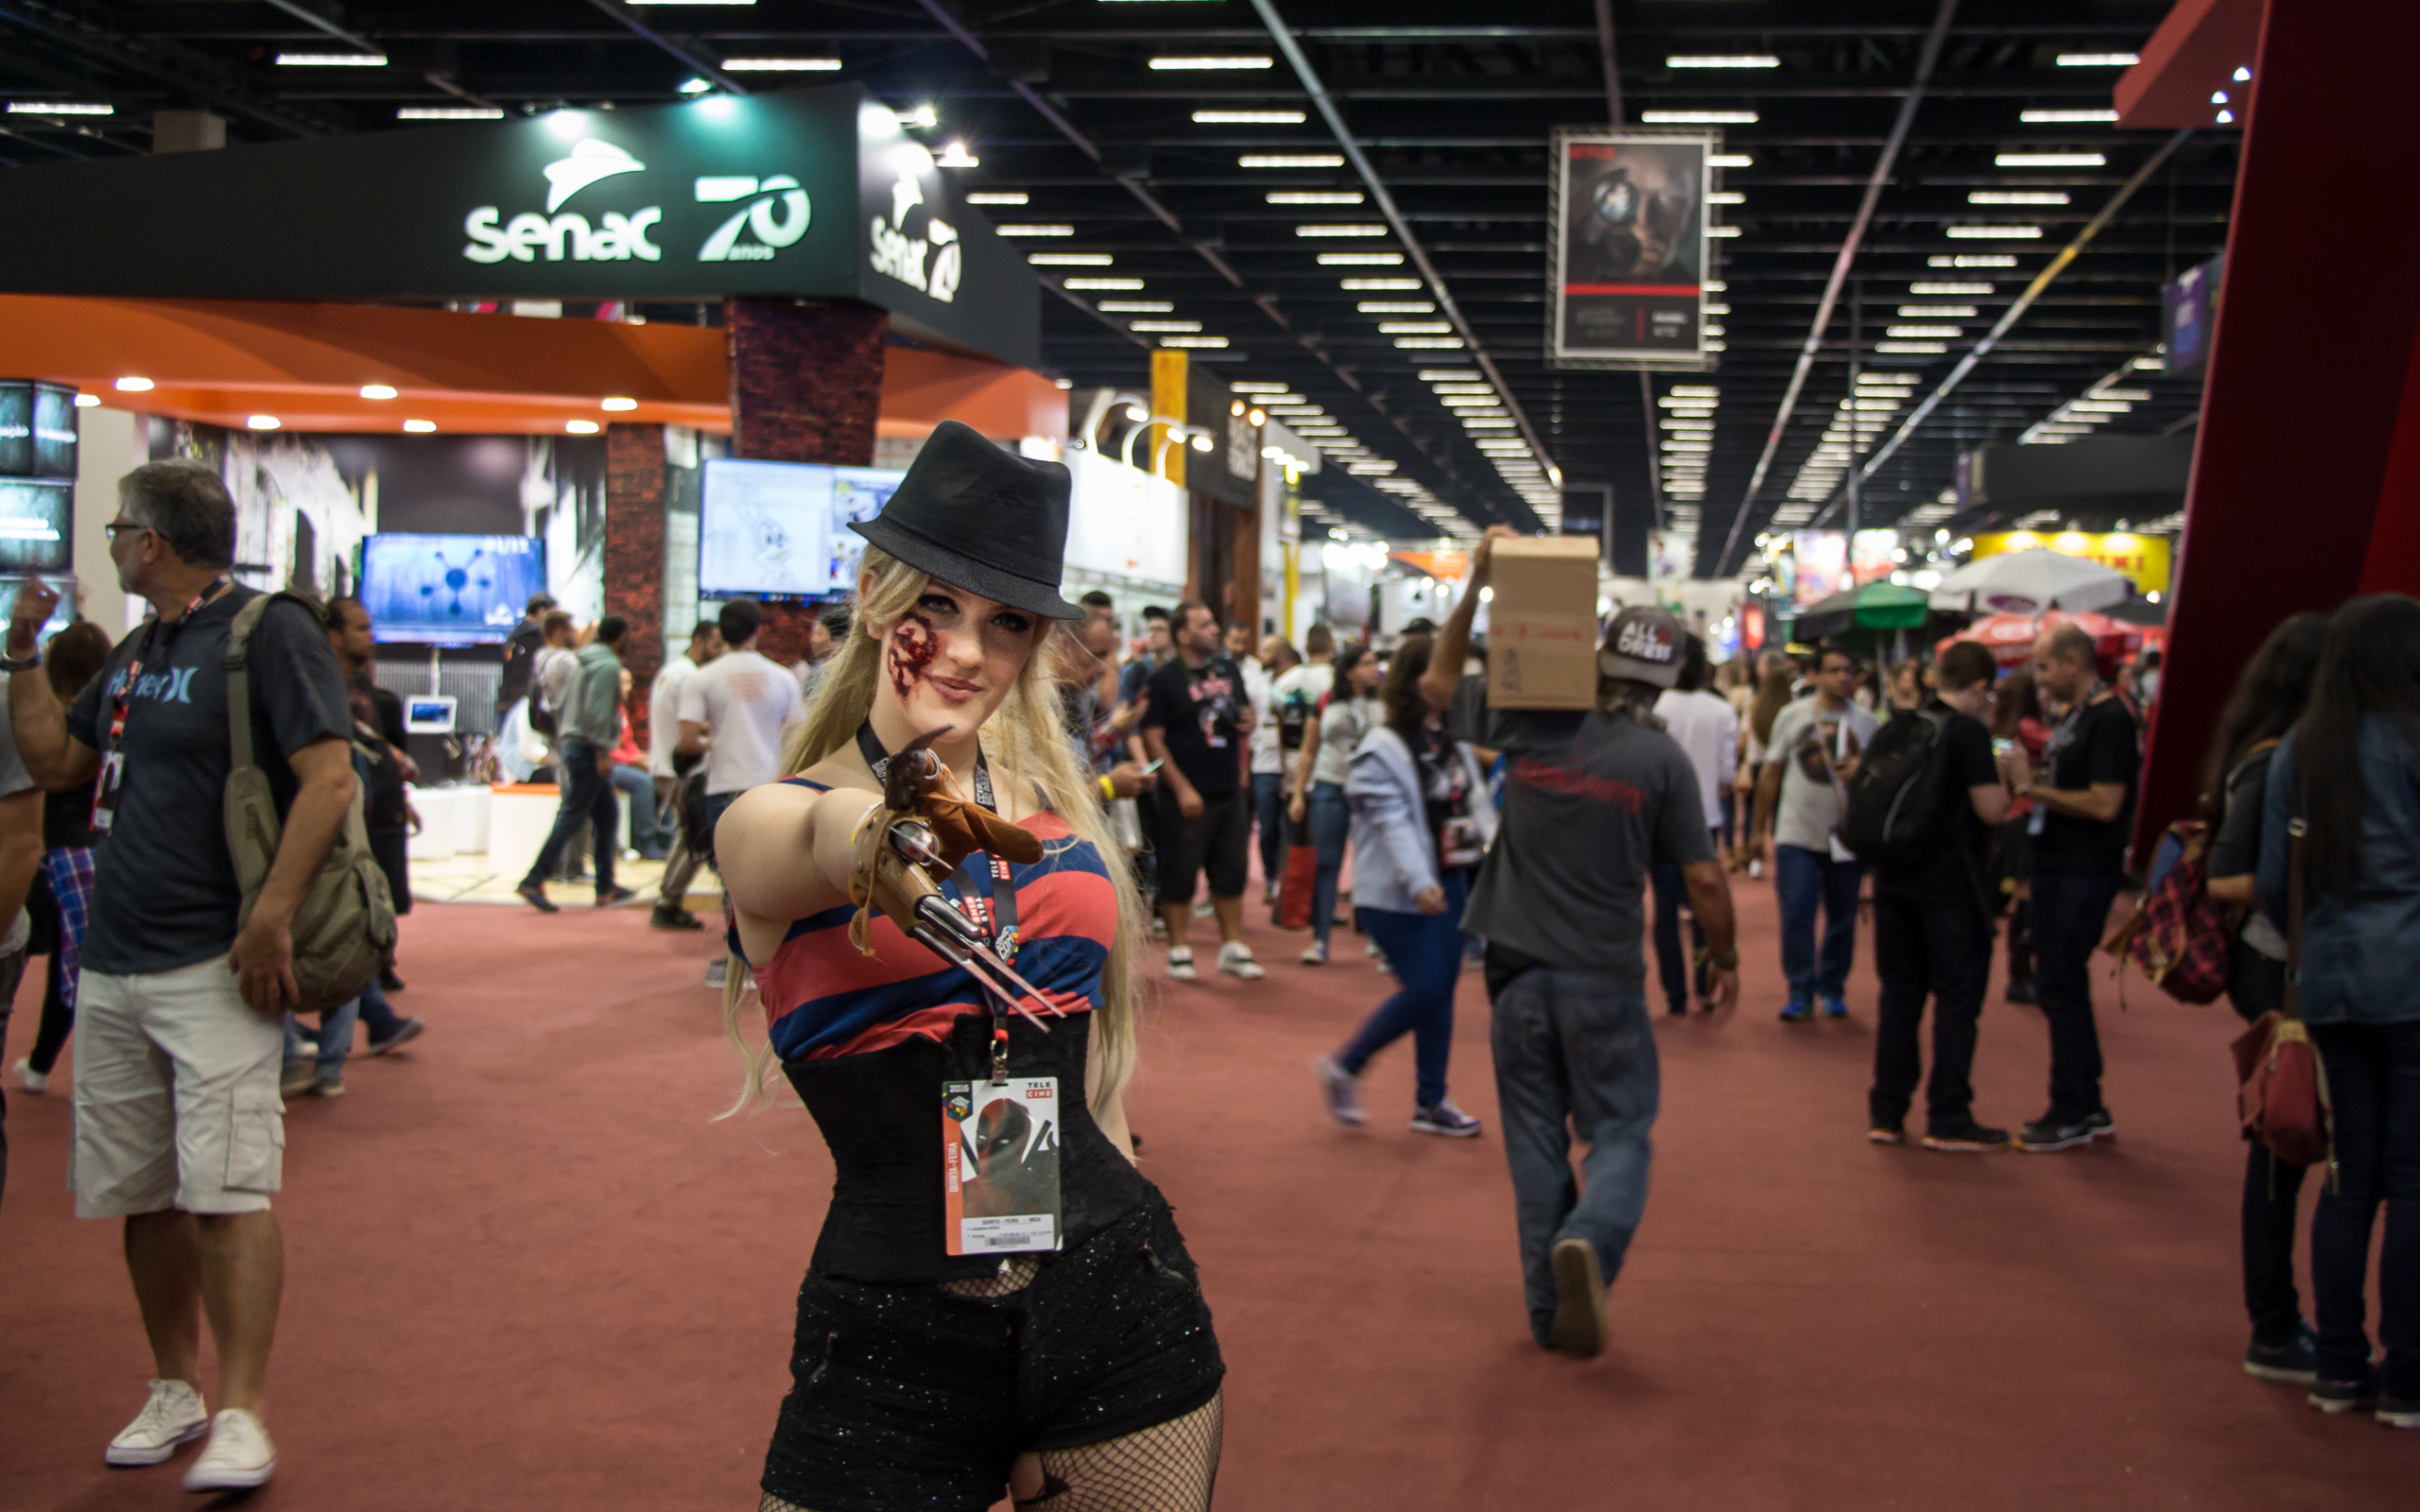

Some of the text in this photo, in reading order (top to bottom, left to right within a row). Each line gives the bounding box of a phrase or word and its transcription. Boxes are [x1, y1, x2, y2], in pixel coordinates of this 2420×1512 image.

[463, 175, 811, 263] Senac 70
[727, 245, 775, 262] anos
[989, 860, 1000, 879] TELE
[999, 860, 1011, 880] CINE
[965, 897, 981, 924] CINE
[975, 897, 989, 922] TELE
[1027, 1090, 1051, 1098] CINE
